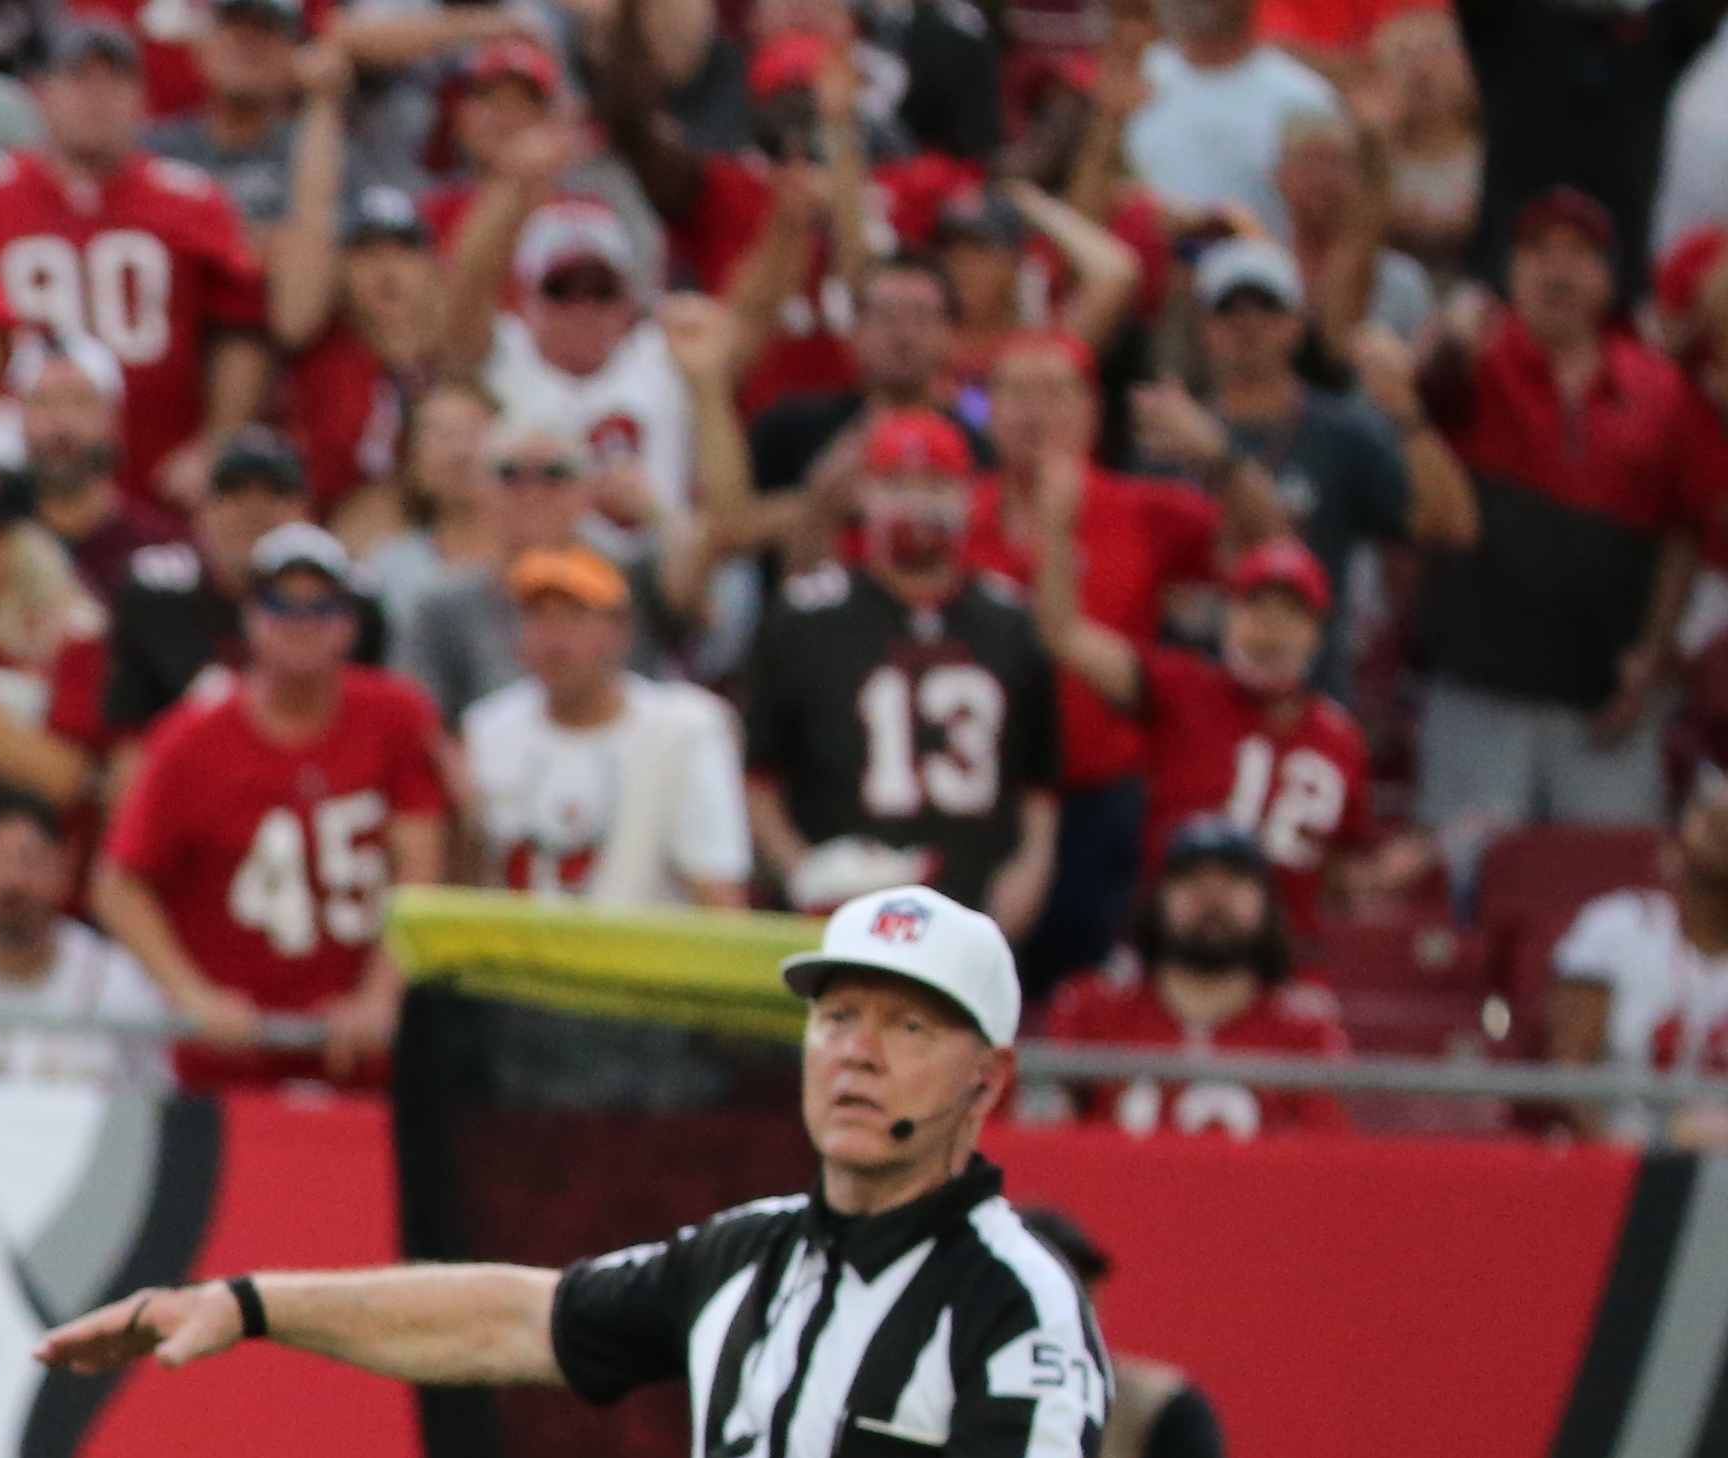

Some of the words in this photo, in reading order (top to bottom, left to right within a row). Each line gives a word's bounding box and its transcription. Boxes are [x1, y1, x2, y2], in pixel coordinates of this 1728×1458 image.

[856, 665, 1007, 818] 13
[1230, 733, 1345, 868] 12
[227, 789, 388, 958] 45
